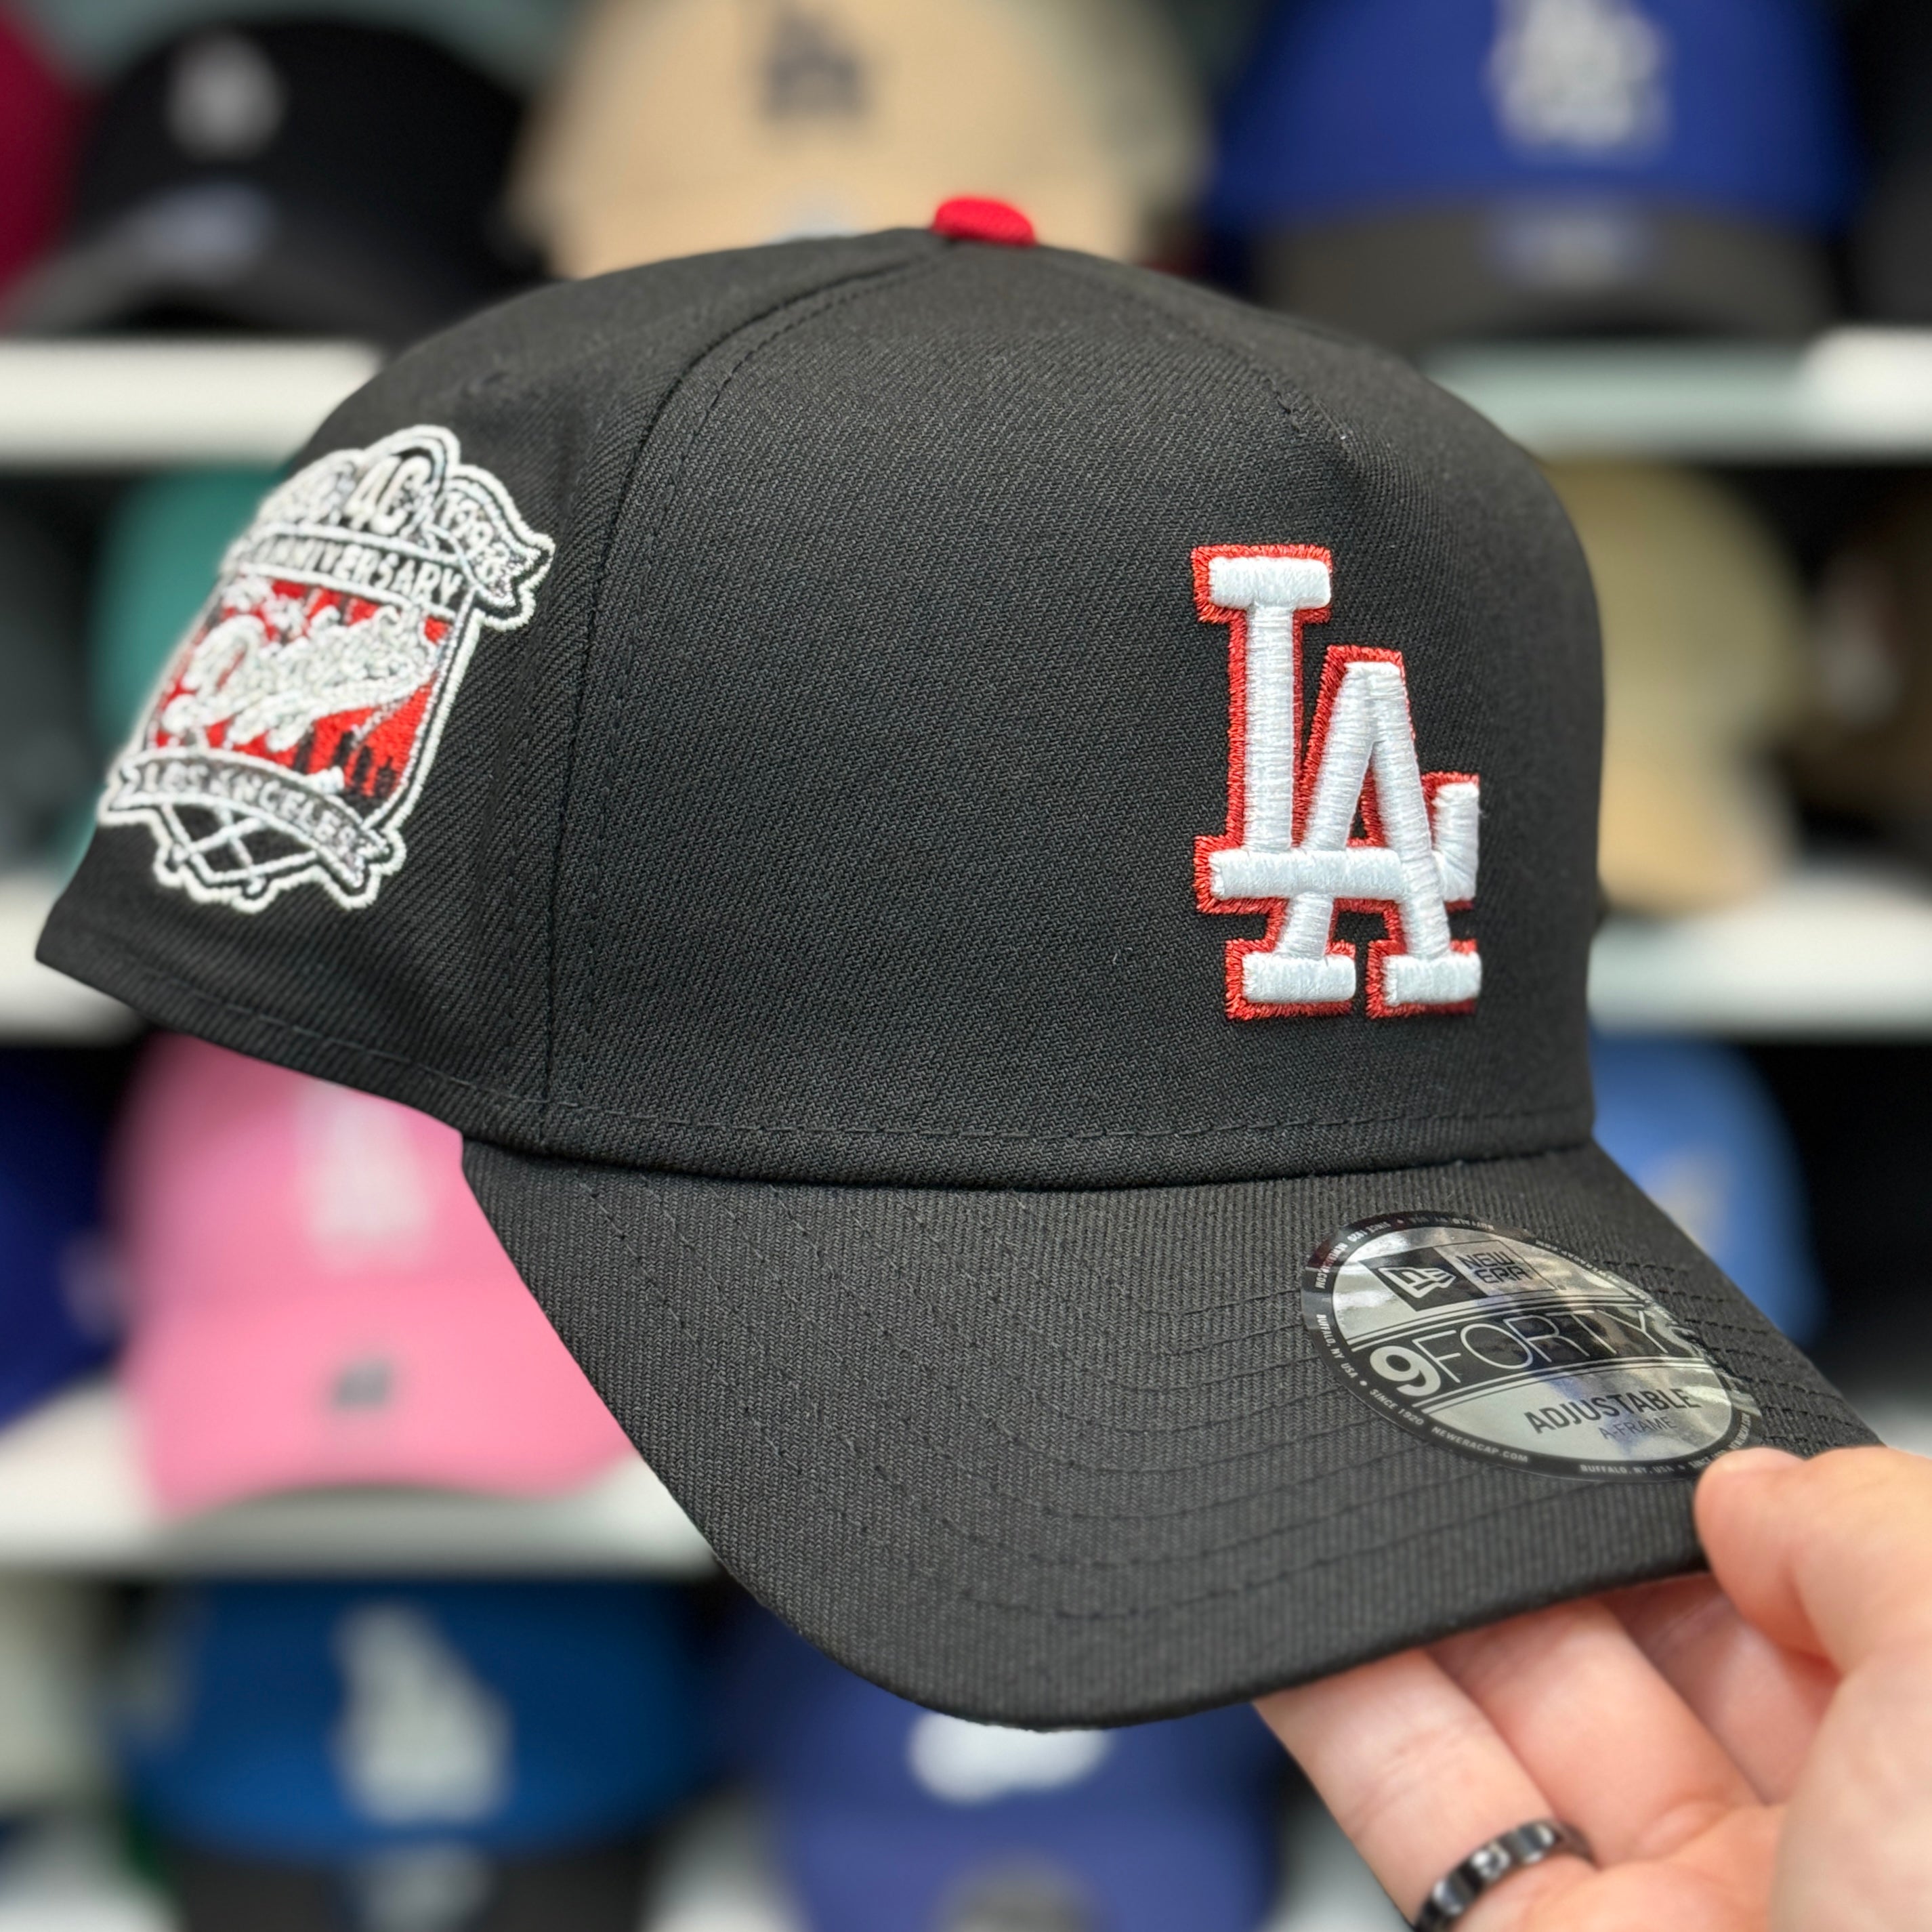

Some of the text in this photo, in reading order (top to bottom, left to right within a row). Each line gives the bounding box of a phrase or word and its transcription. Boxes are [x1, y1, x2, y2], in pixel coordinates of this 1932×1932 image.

[1191, 544, 1482, 1019] LA
[1456, 1251, 1516, 1269] NEW
[1474, 1266, 1535, 1284] ERA
[1330, 1347, 1345, 1360] NY
[1340, 1362, 1359, 1379] USA
[1369, 1309, 1670, 1397] 9FORTY
[1369, 1388, 1529, 1463] SINCE 1920 NEWERACAP.COM
[1524, 1388, 1702, 1435] ADJUSTABLE
[1597, 1415, 1678, 1440] A-FRAME
[1652, 1465, 1675, 1474] USA
